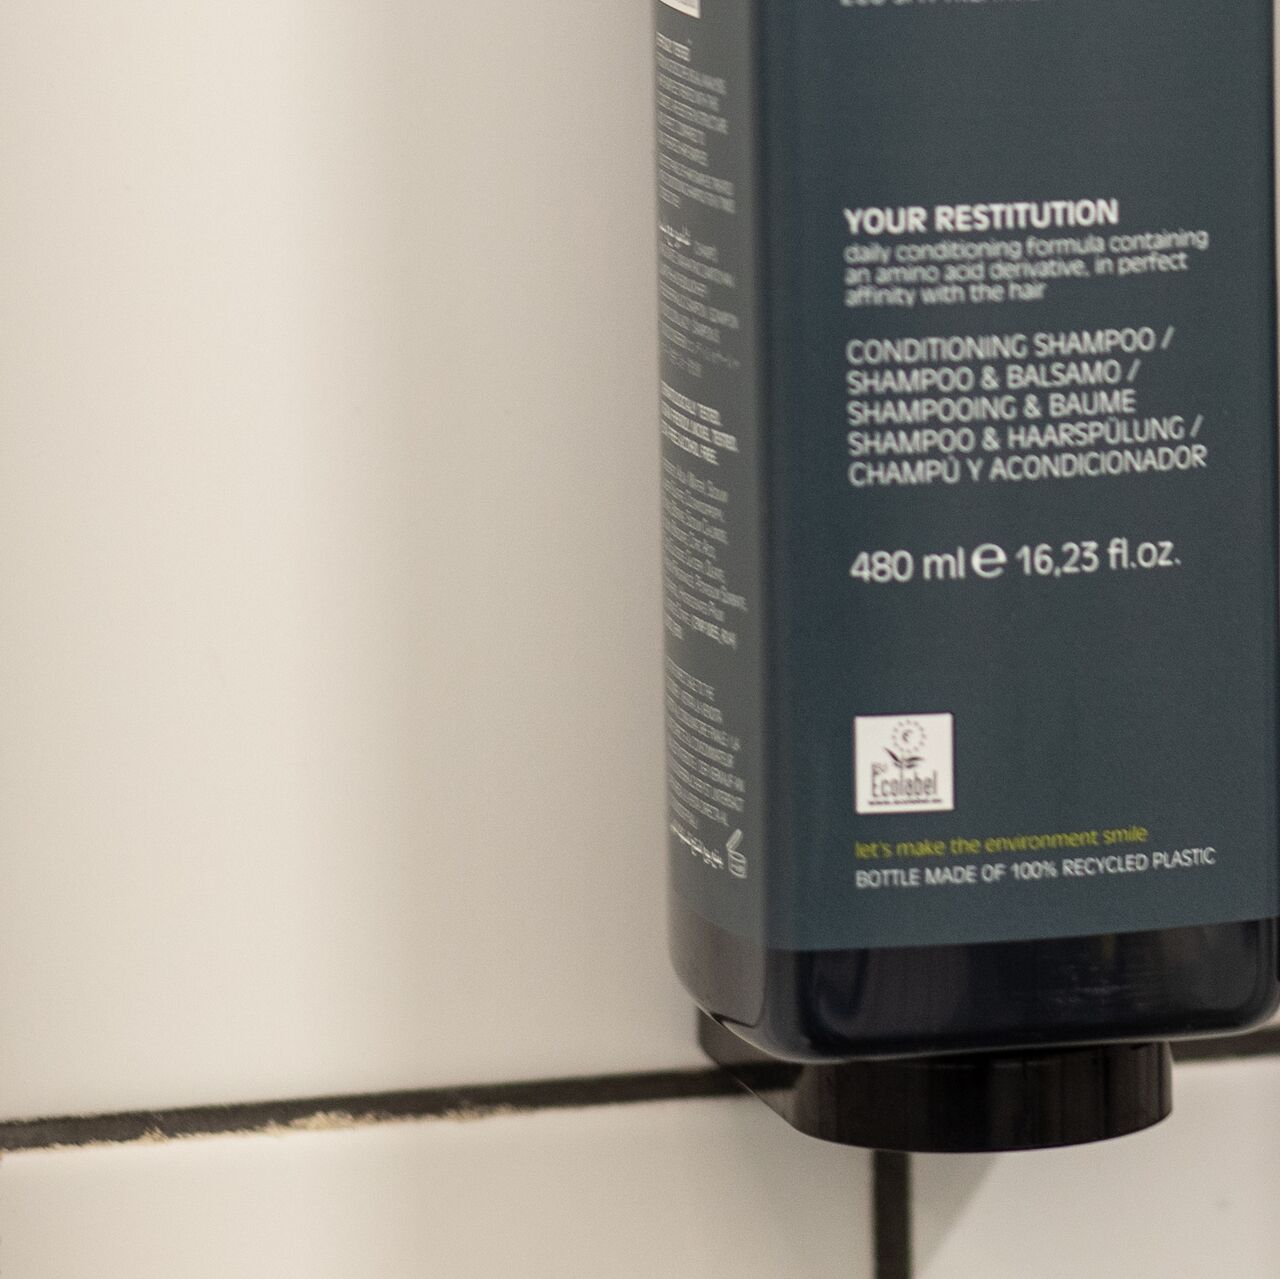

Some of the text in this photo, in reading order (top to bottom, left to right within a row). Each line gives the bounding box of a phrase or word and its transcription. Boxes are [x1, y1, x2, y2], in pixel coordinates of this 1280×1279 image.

[844, 199, 1119, 235] YOUR RESTITUTION
[844, 228, 1209, 266] daily conditioning formula containing
[844, 266, 870, 285] an
[875, 263, 939, 283] amino
[943, 259, 984, 282] acid
[1096, 255, 1114, 275] in
[1118, 250, 1187, 276] perfect
[844, 278, 1046, 308] affinity with the hair
[846, 333, 1028, 365] CONDITIONING
[1033, 327, 1154, 356] SHAMPOO
[846, 366, 973, 396] SHAMPOO
[981, 365, 1001, 388] &
[1006, 359, 1120, 387] BALSAMO
[847, 388, 1136, 426] SHAMPOOING & BAUME
[848, 427, 974, 457] SHAMPOO
[982, 426, 1001, 449] &
[1007, 417, 1185, 448] HAARSPÜLUNG
[965, 457, 984, 481] Y
[989, 445, 1208, 480] ACONDICIONADOR
[850, 548, 914, 583] 480
[1107, 538, 1181, 569] fl.oz.
[871, 769, 937, 797] Ecolabel
[855, 825, 1148, 859] let's make the environment smile
[856, 847, 1216, 889] BOTTLE MADE OF 100% RECYCLED PLASTIC
